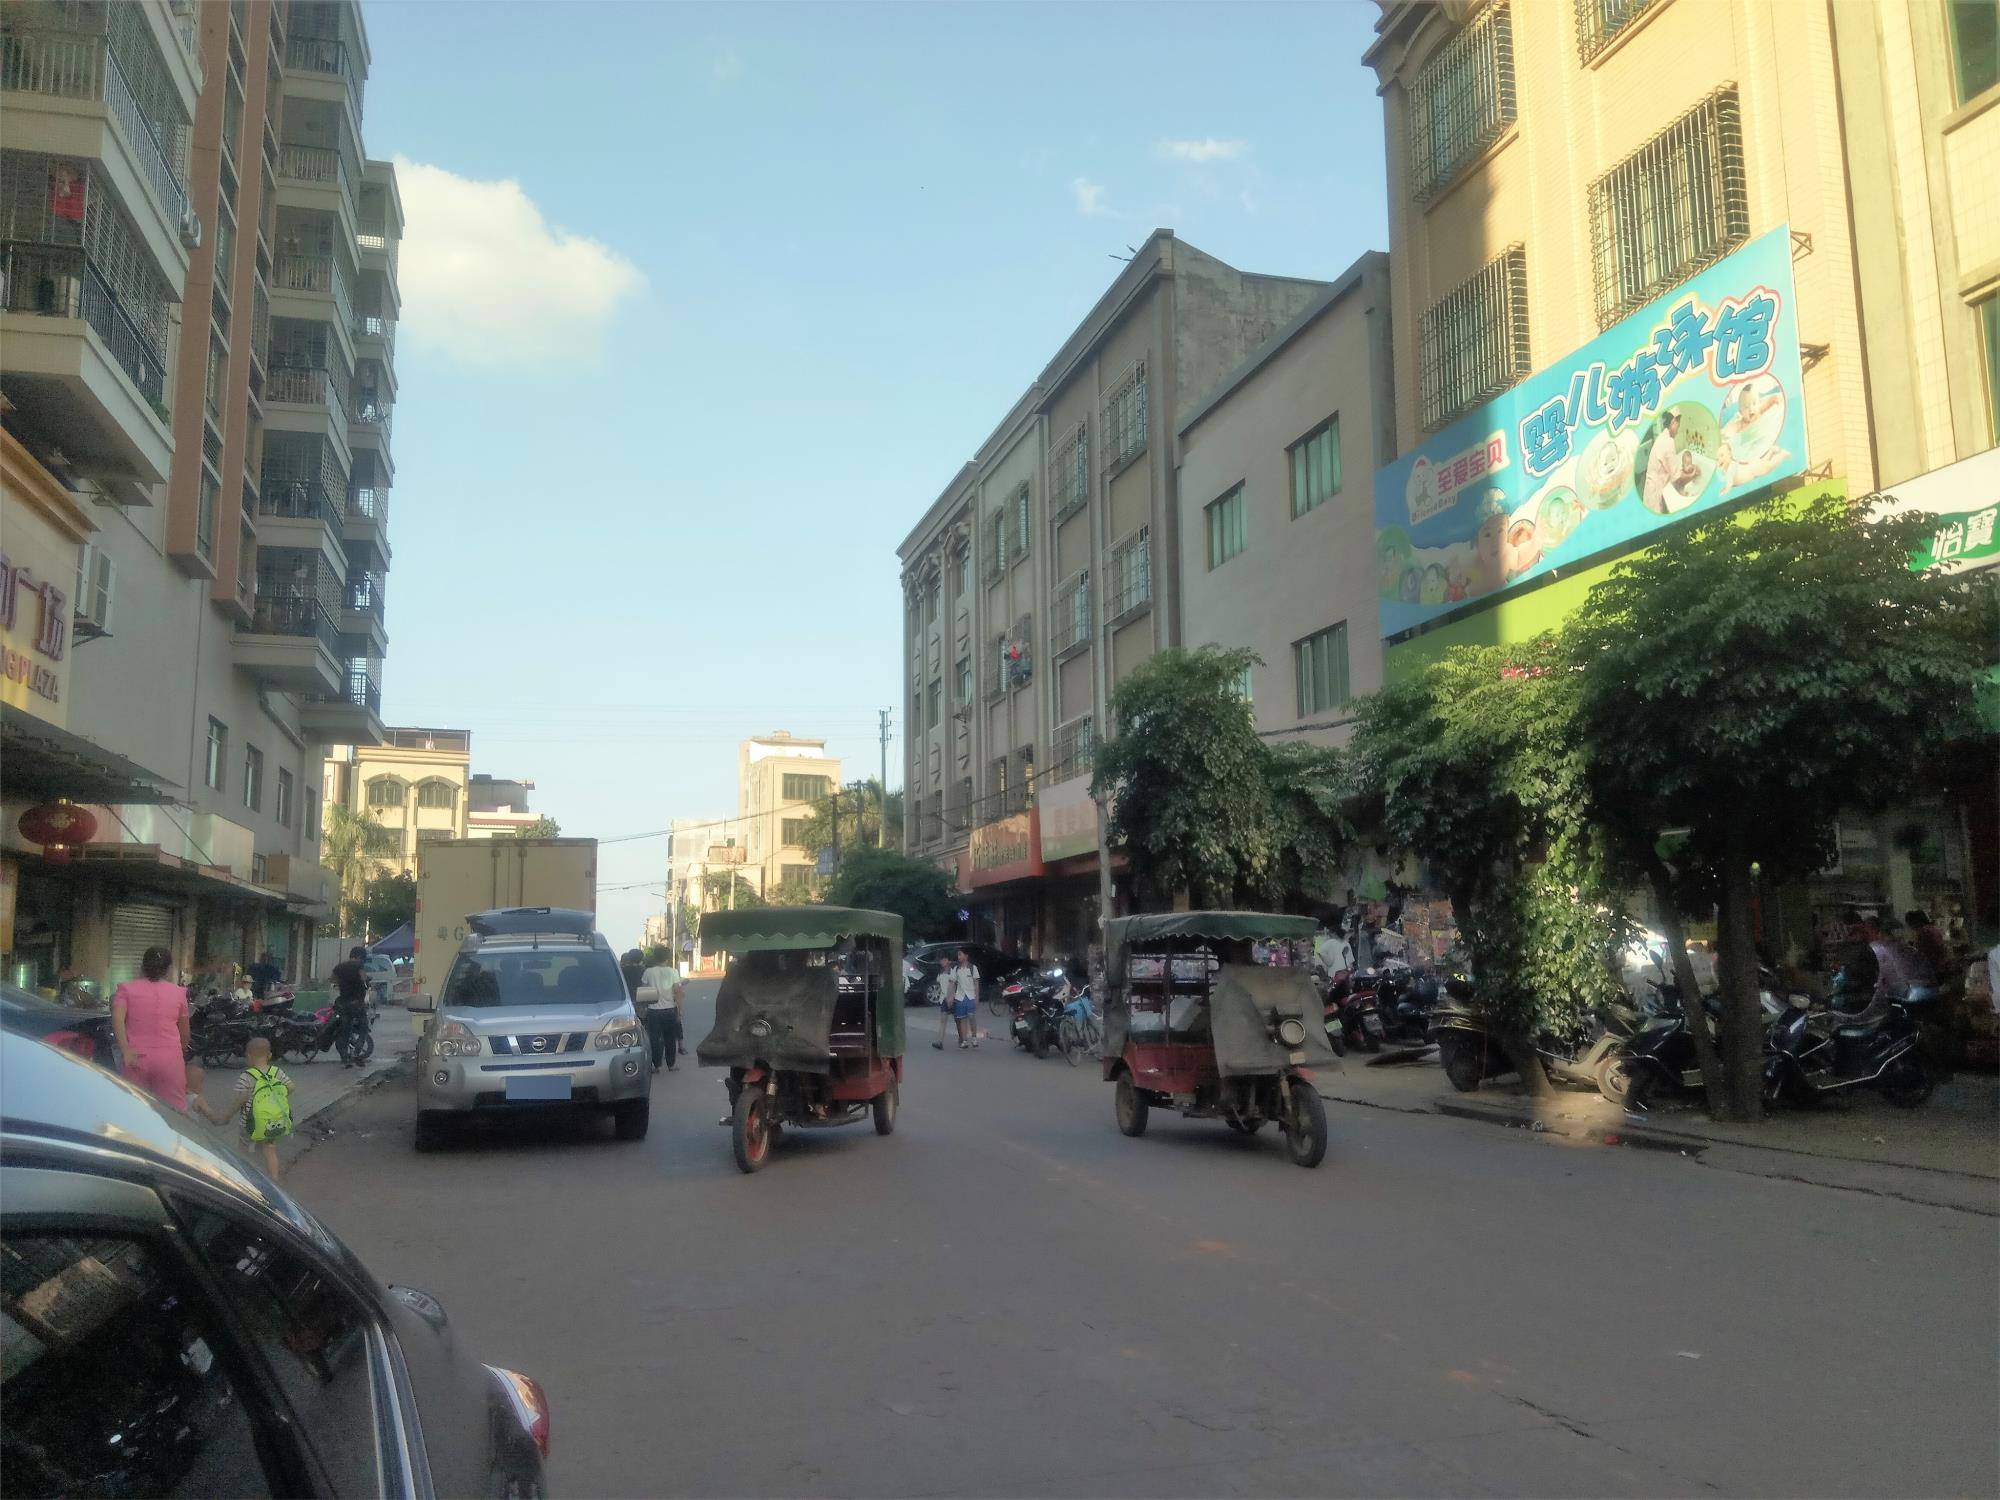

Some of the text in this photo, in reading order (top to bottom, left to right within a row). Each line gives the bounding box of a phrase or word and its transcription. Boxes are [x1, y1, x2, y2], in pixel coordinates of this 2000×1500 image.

[1522, 294, 1775, 473] 婴儿游泳馆
[1438, 438, 1503, 496] 至爱宝贝
